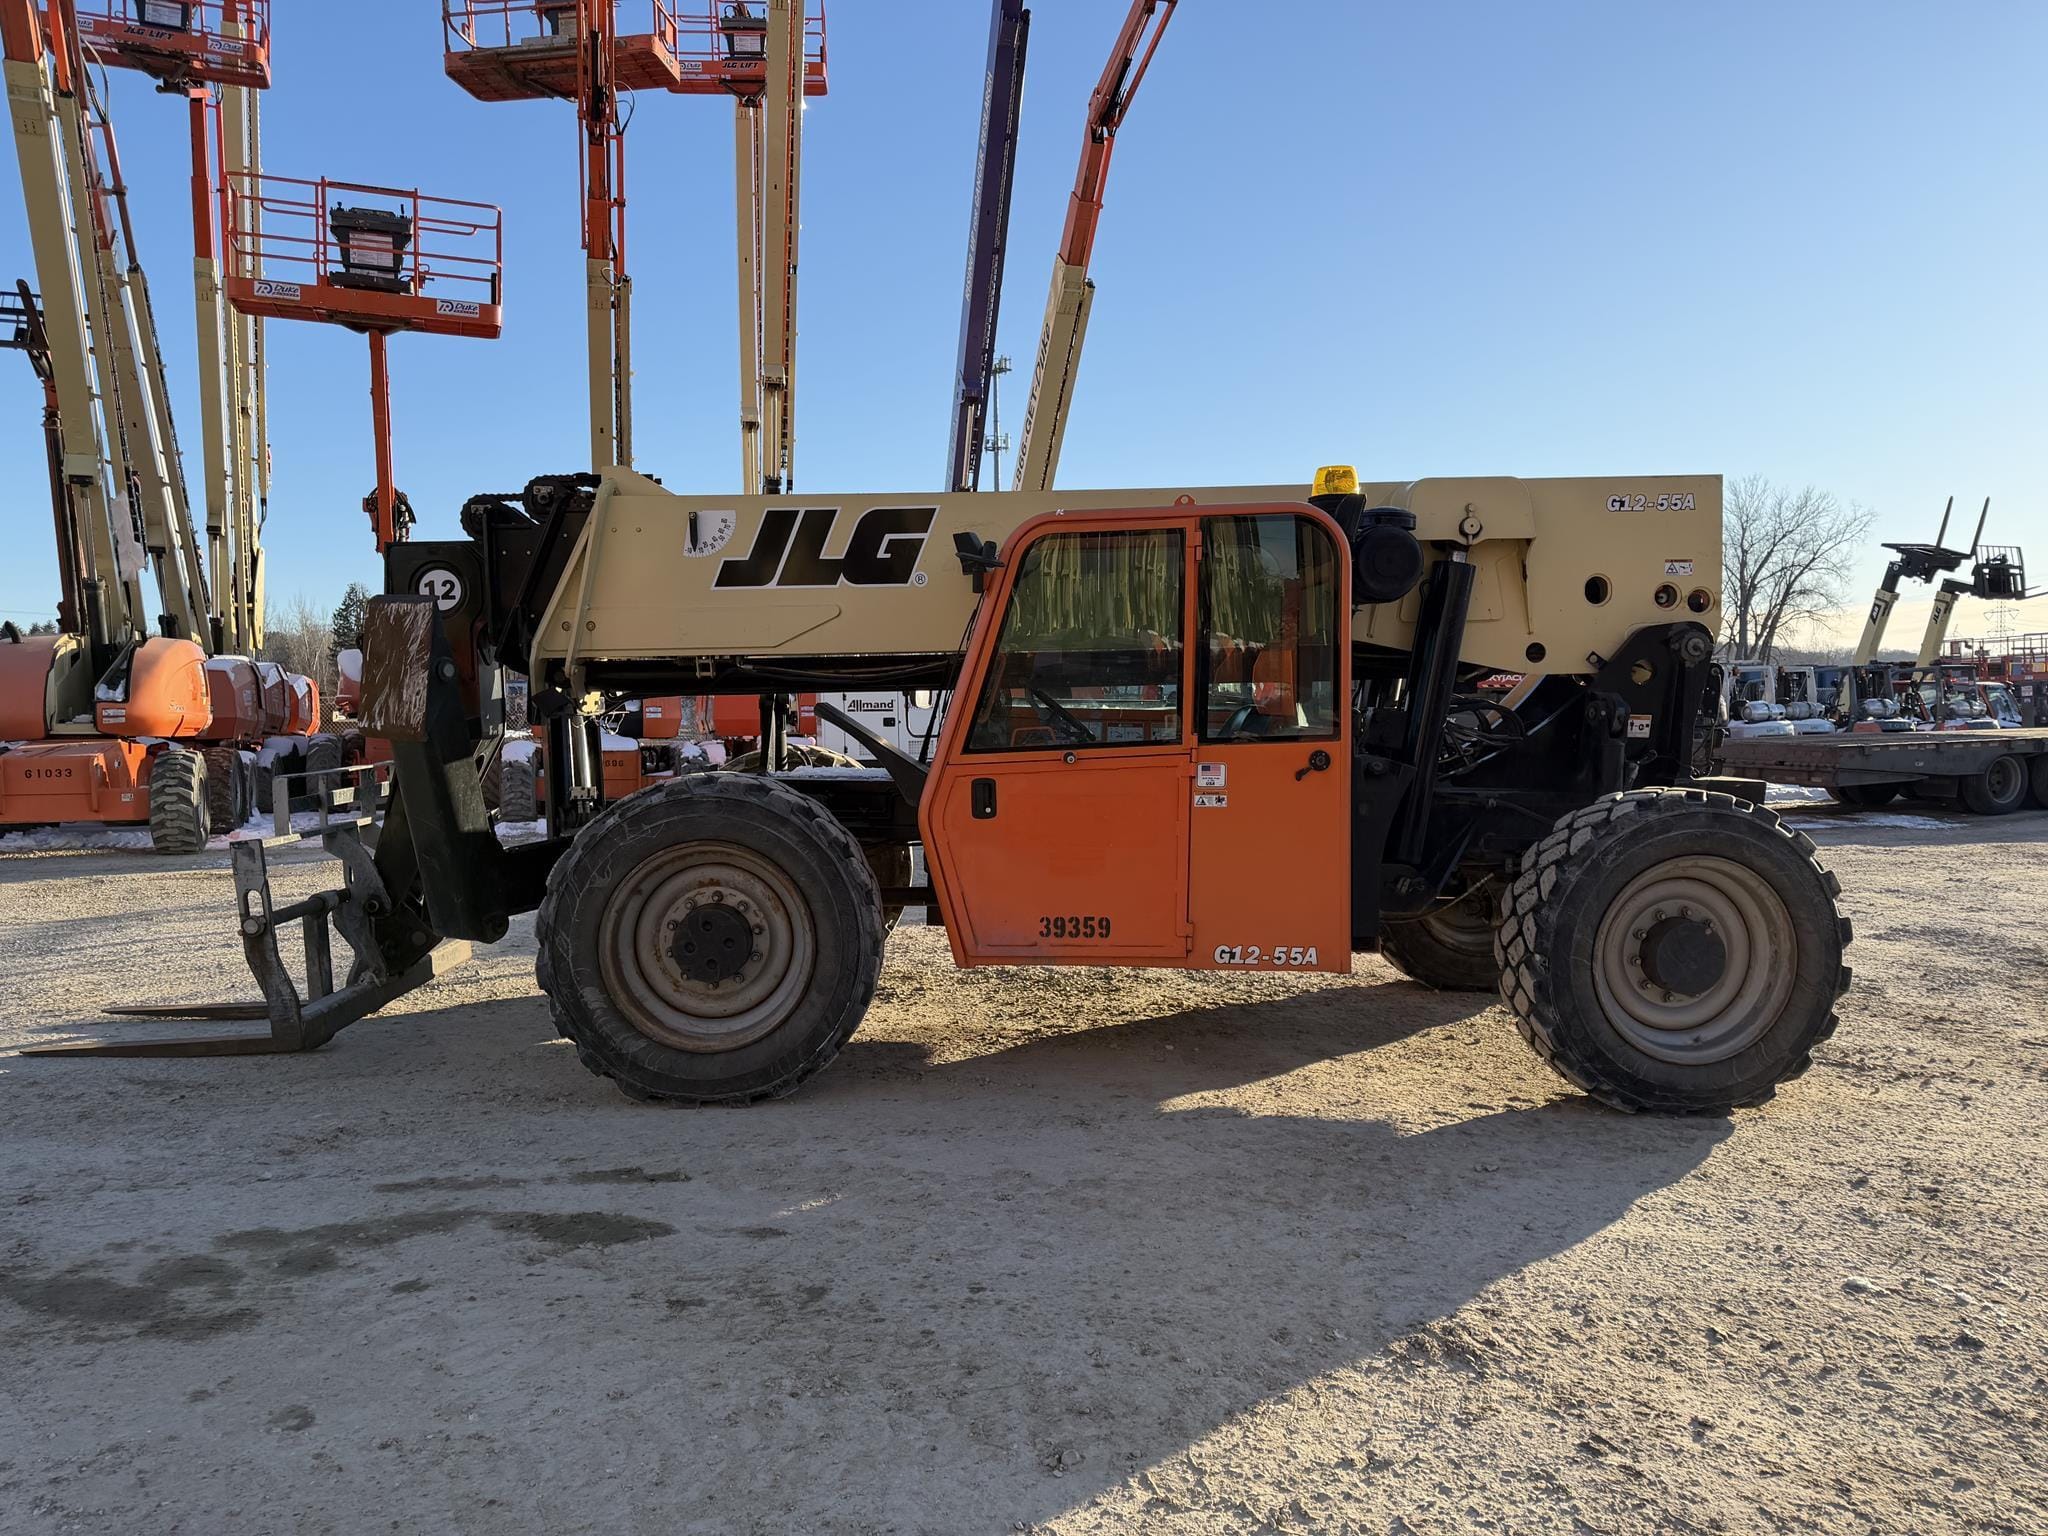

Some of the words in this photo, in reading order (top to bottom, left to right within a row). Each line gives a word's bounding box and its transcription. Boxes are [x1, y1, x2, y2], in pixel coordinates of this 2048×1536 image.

[149, 30, 175, 40] LIFT
[974, 148, 985, 207] CANCER
[980, 71, 993, 146] RESEARCH
[274, 285, 299, 294] Duke
[1606, 493, 1696, 512] G12-55A
[711, 505, 940, 590] JLG
[423, 579, 457, 600] 12
[847, 699, 894, 712] Allmand
[1039, 916, 1111, 938] 39359
[1213, 944, 1318, 965] G12-55A
